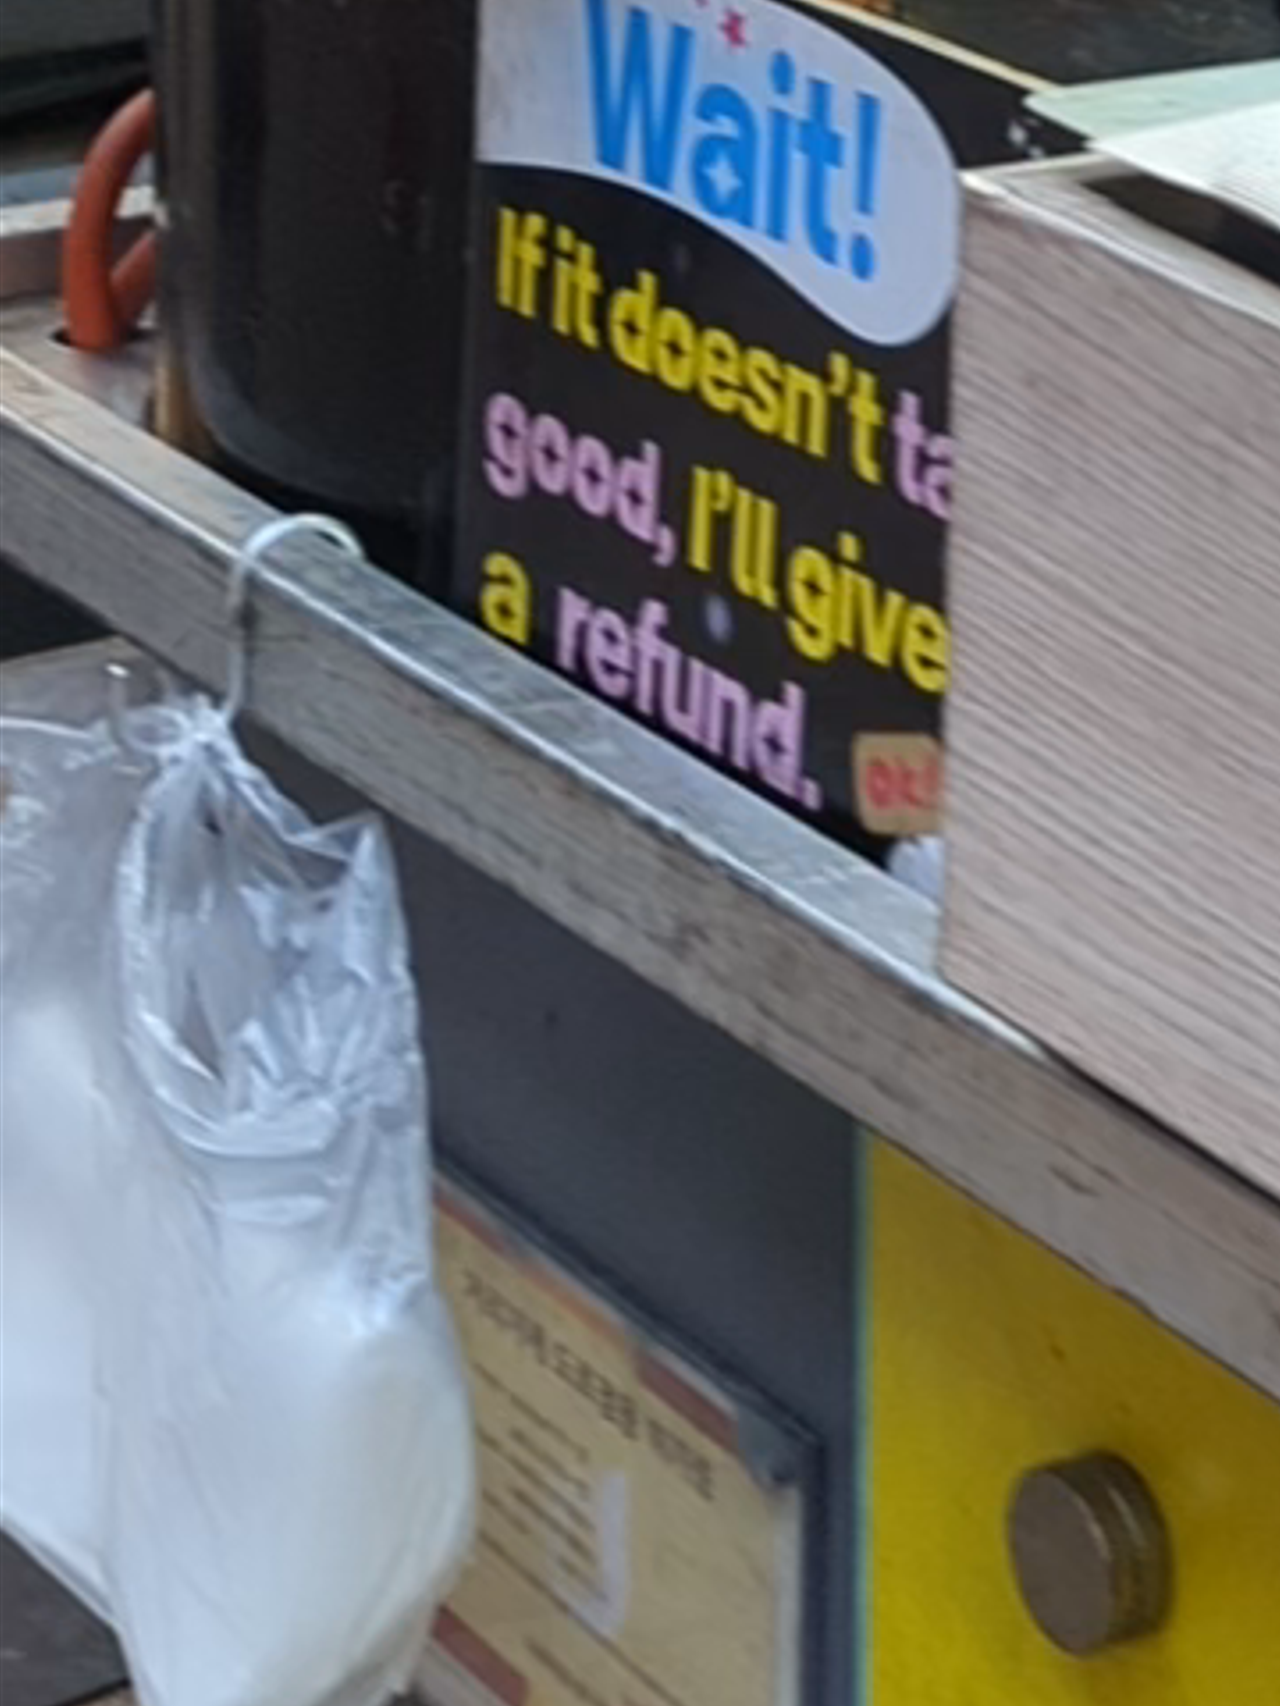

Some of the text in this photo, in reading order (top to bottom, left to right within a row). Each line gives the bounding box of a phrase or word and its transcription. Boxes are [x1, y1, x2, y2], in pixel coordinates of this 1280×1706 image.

[496, 206, 550, 320] If
[553, 223, 602, 349] it
[606, 270, 885, 486] doesn't
[480, 549, 822, 812] a refund.
[482, 392, 949, 695] good, I'll give
